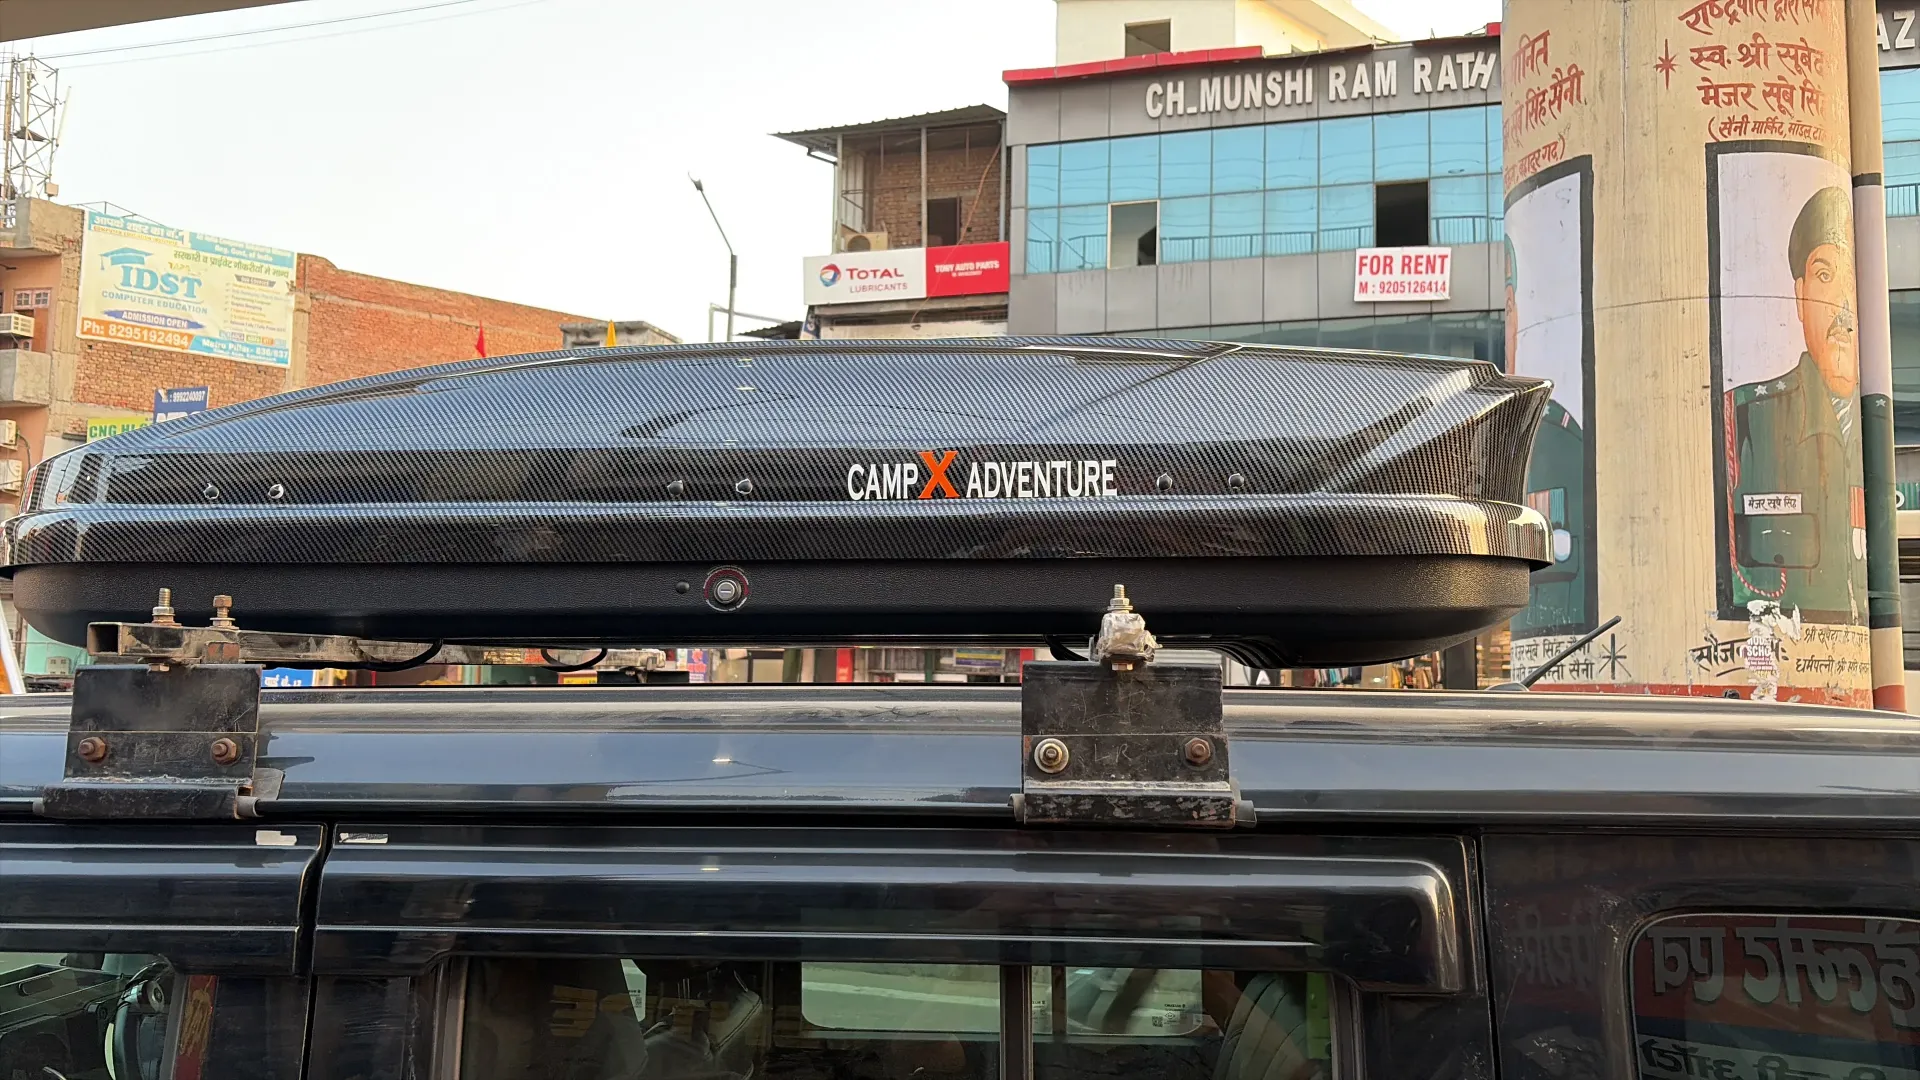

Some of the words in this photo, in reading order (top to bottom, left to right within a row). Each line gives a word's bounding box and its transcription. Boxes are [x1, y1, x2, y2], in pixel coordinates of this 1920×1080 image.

[1737, 32, 1772, 70] श्री
[1328, 59, 1398, 101] RAM
[1547, 63, 1585, 120] सैनी
[1696, 77, 1758, 110] मेजर
[1762, 75, 1796, 119] सूबे
[846, 267, 904, 281] TOTAL
[1358, 254, 1393, 276] FOR
[1400, 254, 1449, 275] RENT
[120, 265, 203, 299] IDST
[849, 282, 908, 294] LUBRICANTS
[1379, 280, 1446, 294] 9205126414
[101, 290, 154, 307] COMPUTER
[157, 300, 208, 315] EDUCATION
[121, 309, 165, 326] ADMISSION
[166, 317, 188, 328] OPEN
[83, 320, 104, 335] Ph:
[108, 324, 189, 348] 8295192494
[89, 424, 117, 438] CNG
[966, 459, 1118, 498] ADVENTURE
